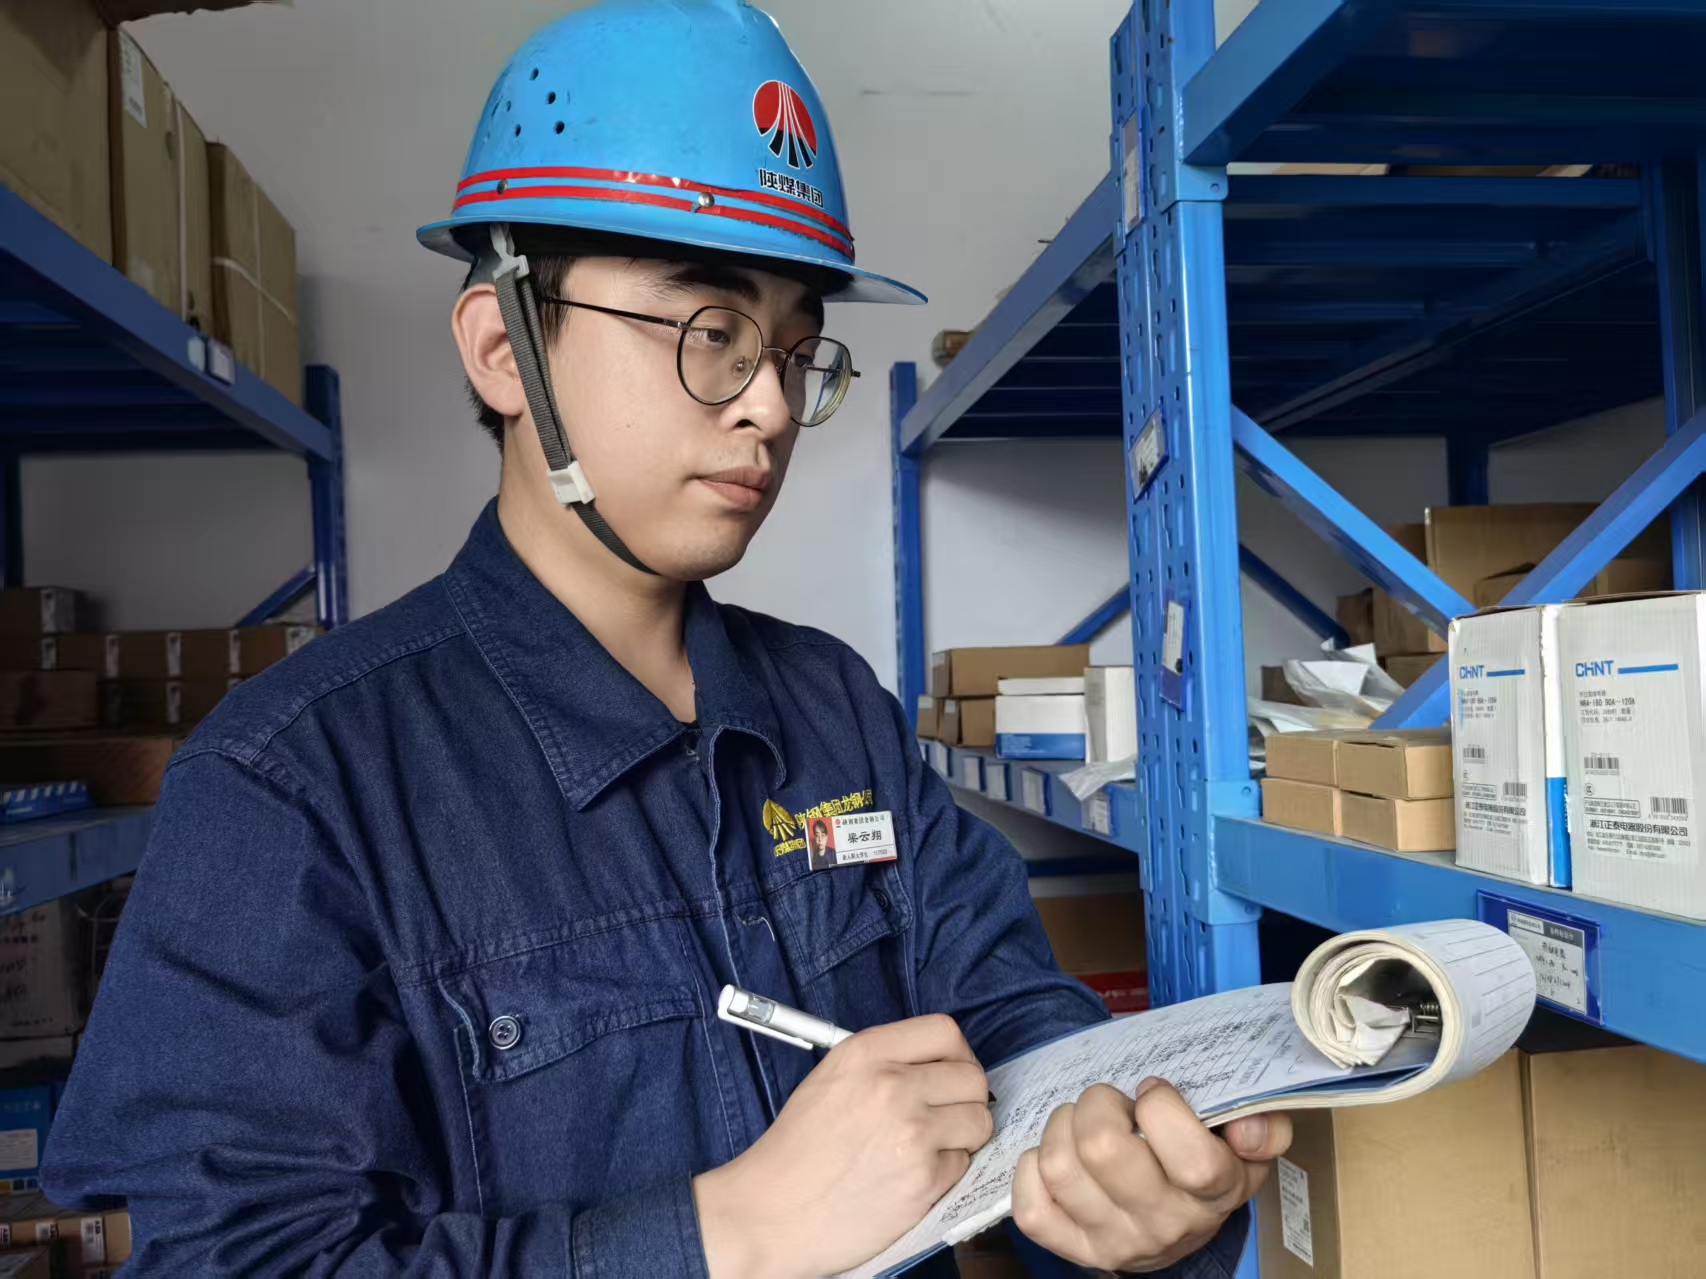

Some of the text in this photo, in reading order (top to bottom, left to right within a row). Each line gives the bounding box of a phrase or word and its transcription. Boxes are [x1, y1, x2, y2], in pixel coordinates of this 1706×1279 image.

[759, 168, 824, 208] 陕煤集团
[848, 829, 882, 843] 梁云翔
[1590, 819, 1688, 837] 浙江正泰电器股份有限公司
